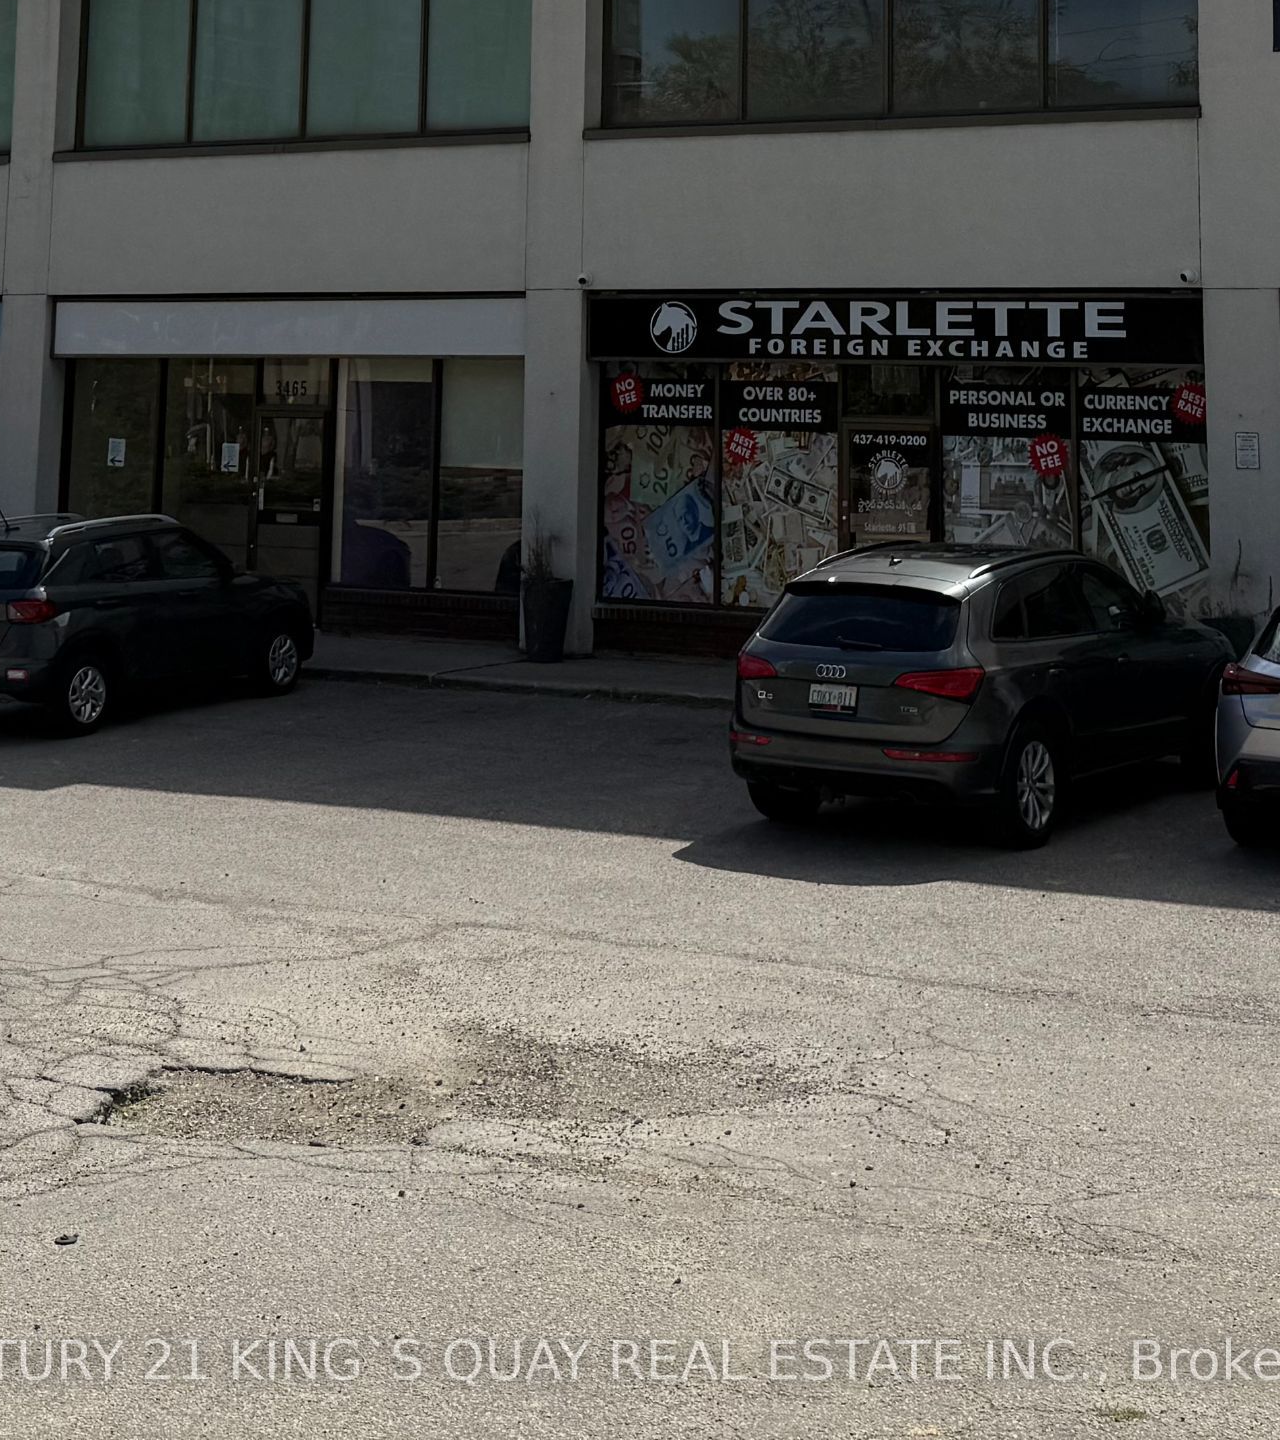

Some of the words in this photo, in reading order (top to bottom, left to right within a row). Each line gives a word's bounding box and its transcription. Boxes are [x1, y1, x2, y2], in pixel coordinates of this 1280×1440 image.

[716, 300, 1128, 339] STARLETTE
[748, 338, 889, 356] FOREIGN
[907, 340, 1089, 359] EXCHANGE
[615, 378, 635, 393] NO
[650, 383, 705, 398] MONEY
[742, 386, 783, 401] OVER
[787, 387, 817, 402] 80+
[618, 391, 637, 406] FEE
[949, 390, 1036, 407] PERSONAL
[1040, 391, 1066, 407] OR
[1083, 394, 1170, 411] CURRENCY
[1181, 389, 1206, 407] BEST
[641, 404, 713, 420] TRANSFER
[738, 407, 822, 424] COUNTRIES
[1177, 399, 1203, 418] RATE
[968, 412, 1047, 430] BUSINESS
[1082, 416, 1173, 435] EXCHANGE
[733, 432, 754, 449] BEST
[853, 433, 928, 446] 437-419-0200
[1035, 440, 1059, 456] NO
[729, 443, 752, 460] RATE
[1039, 453, 1062, 471] FEE
